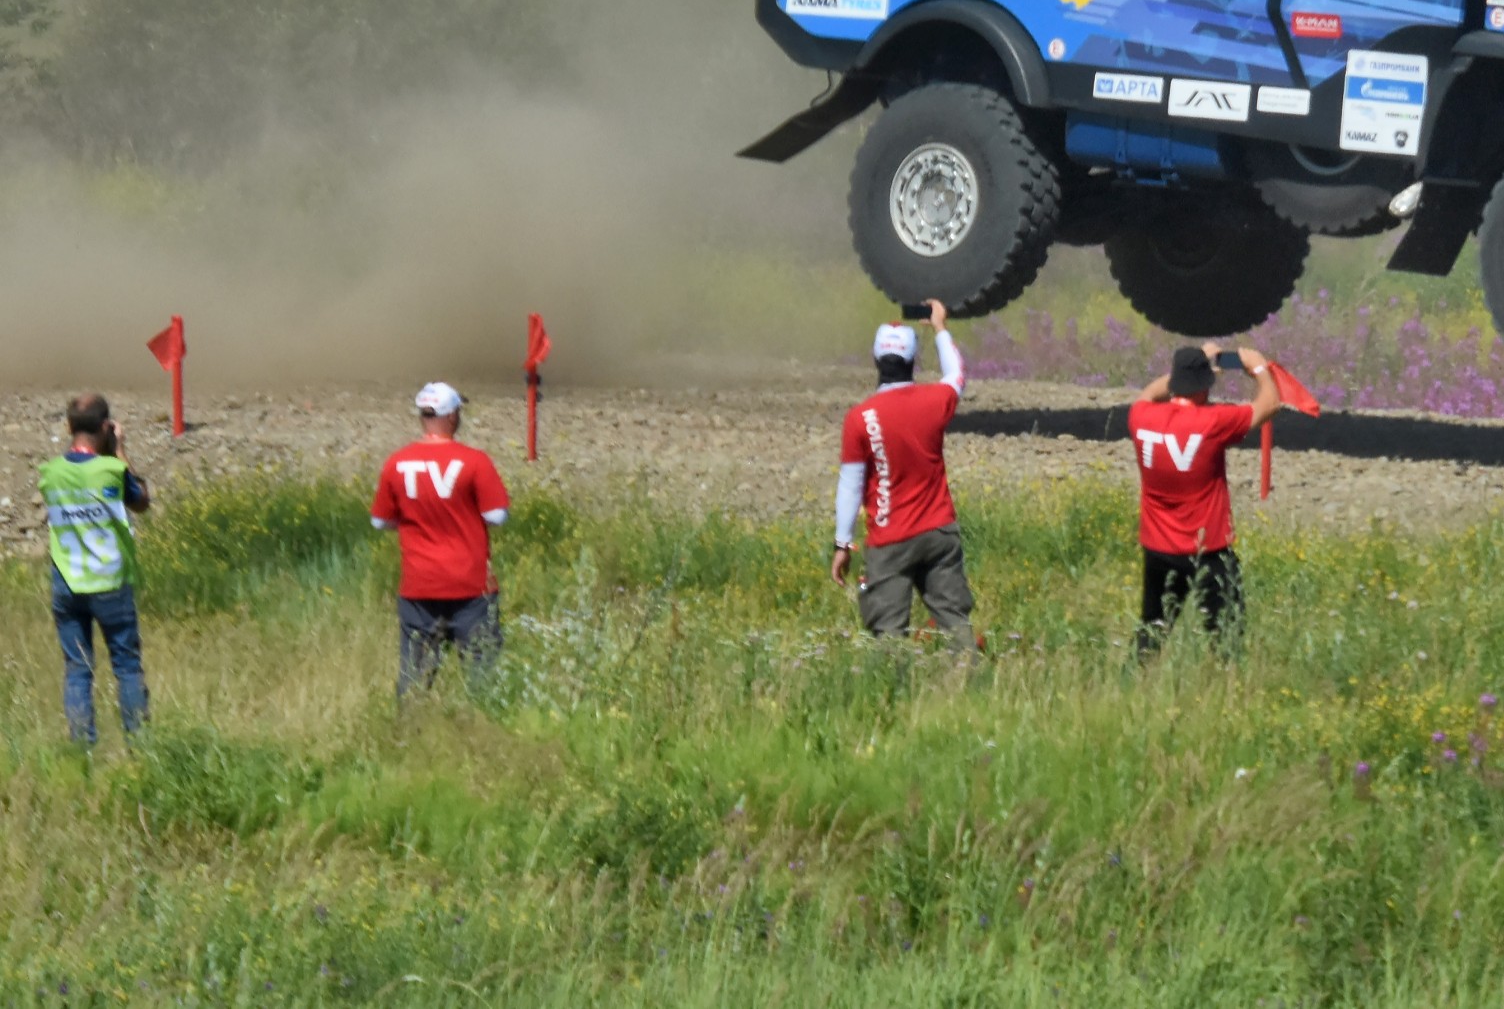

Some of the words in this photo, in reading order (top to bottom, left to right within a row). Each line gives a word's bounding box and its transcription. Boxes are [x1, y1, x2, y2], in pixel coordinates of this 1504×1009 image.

[1346, 131, 1378, 143] KAMAZ
[1136, 428, 1203, 472] TV
[396, 459, 465, 499] TV
